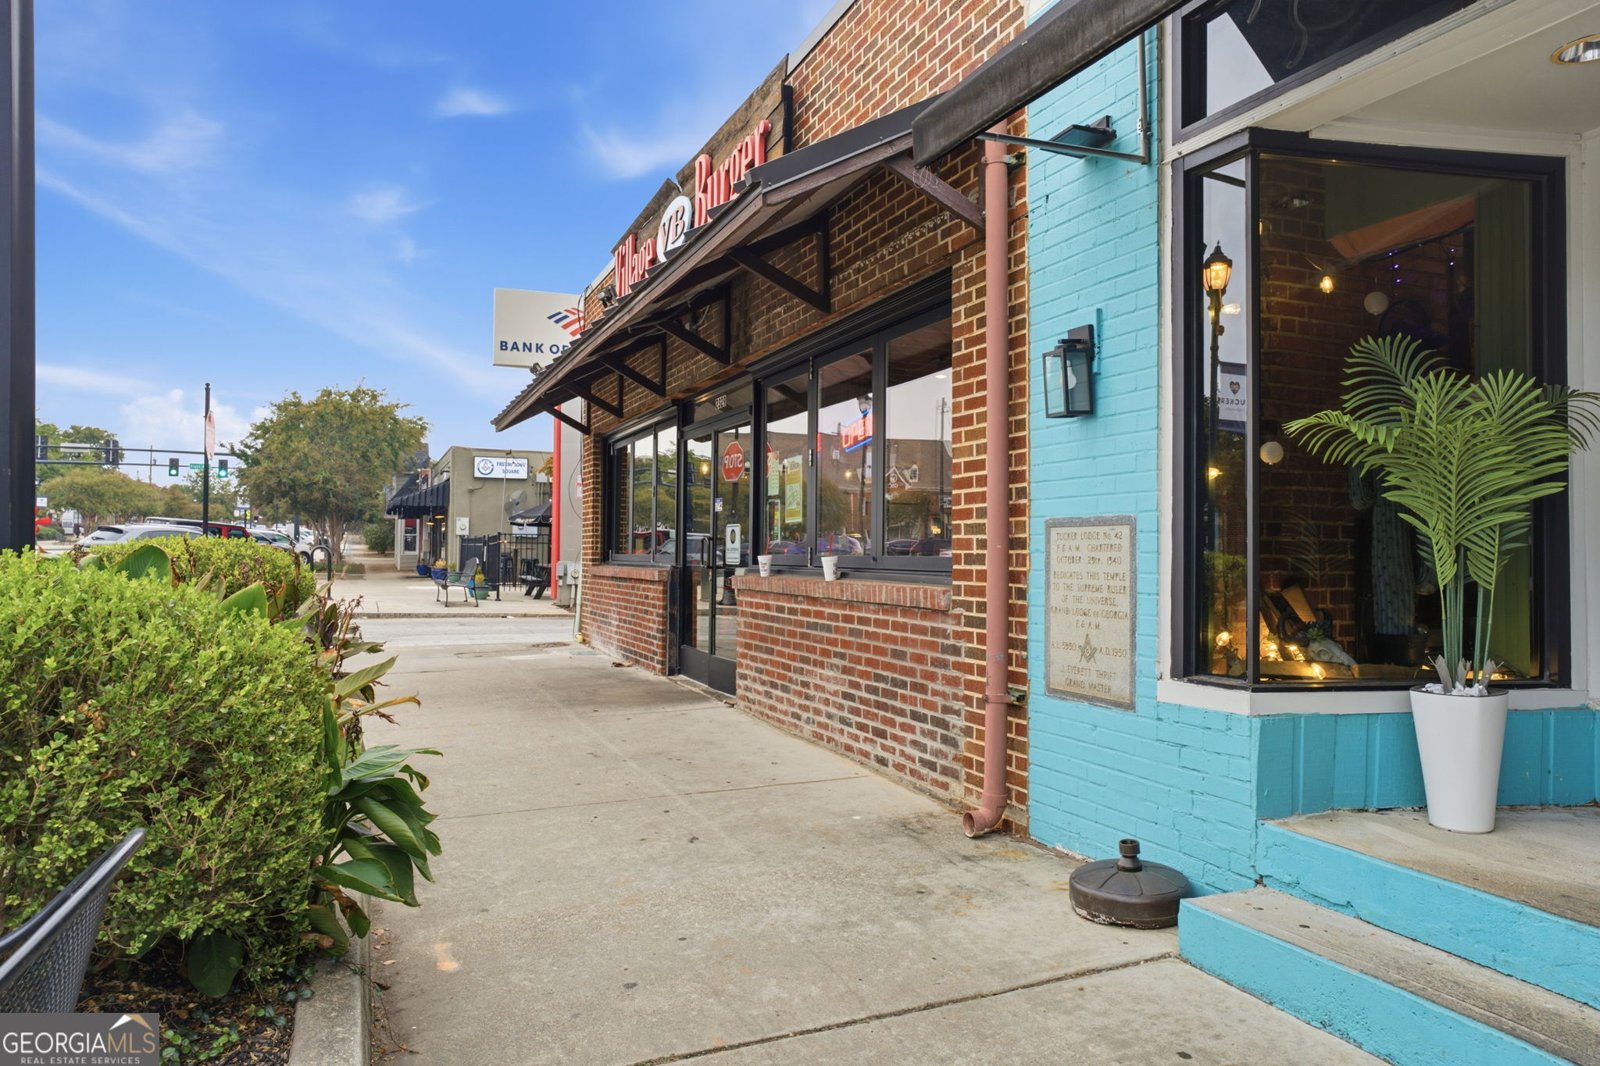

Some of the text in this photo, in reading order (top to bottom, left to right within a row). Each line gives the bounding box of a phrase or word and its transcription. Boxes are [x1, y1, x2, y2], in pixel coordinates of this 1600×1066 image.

[615, 233, 657, 297] Village
[694, 119, 772, 228] Burger
[500, 340, 544, 354] BANK
[1056, 532, 1077, 541] TUCKER
[1080, 531, 1100, 540] LODGE
[1114, 530, 1123, 540] 42
[1087, 543, 1122, 552] CHARTERED
[1056, 555, 1082, 565] OCTOBER
[1053, 570, 1126, 581] DEDICATES THIS TEMPLE
[1053, 583, 1128, 594] TO THE SUPREME RULER
[1061, 594, 1069, 603] OF
[1072, 595, 1083, 604] THE
[1051, 606, 1070, 616] GRAND
[1072, 607, 1091, 617] LODGE
[1101, 609, 1128, 620] GEORGIA
[1067, 665, 1091, 677] EVERETT
[1065, 678, 1112, 694] GRAND MASTER
